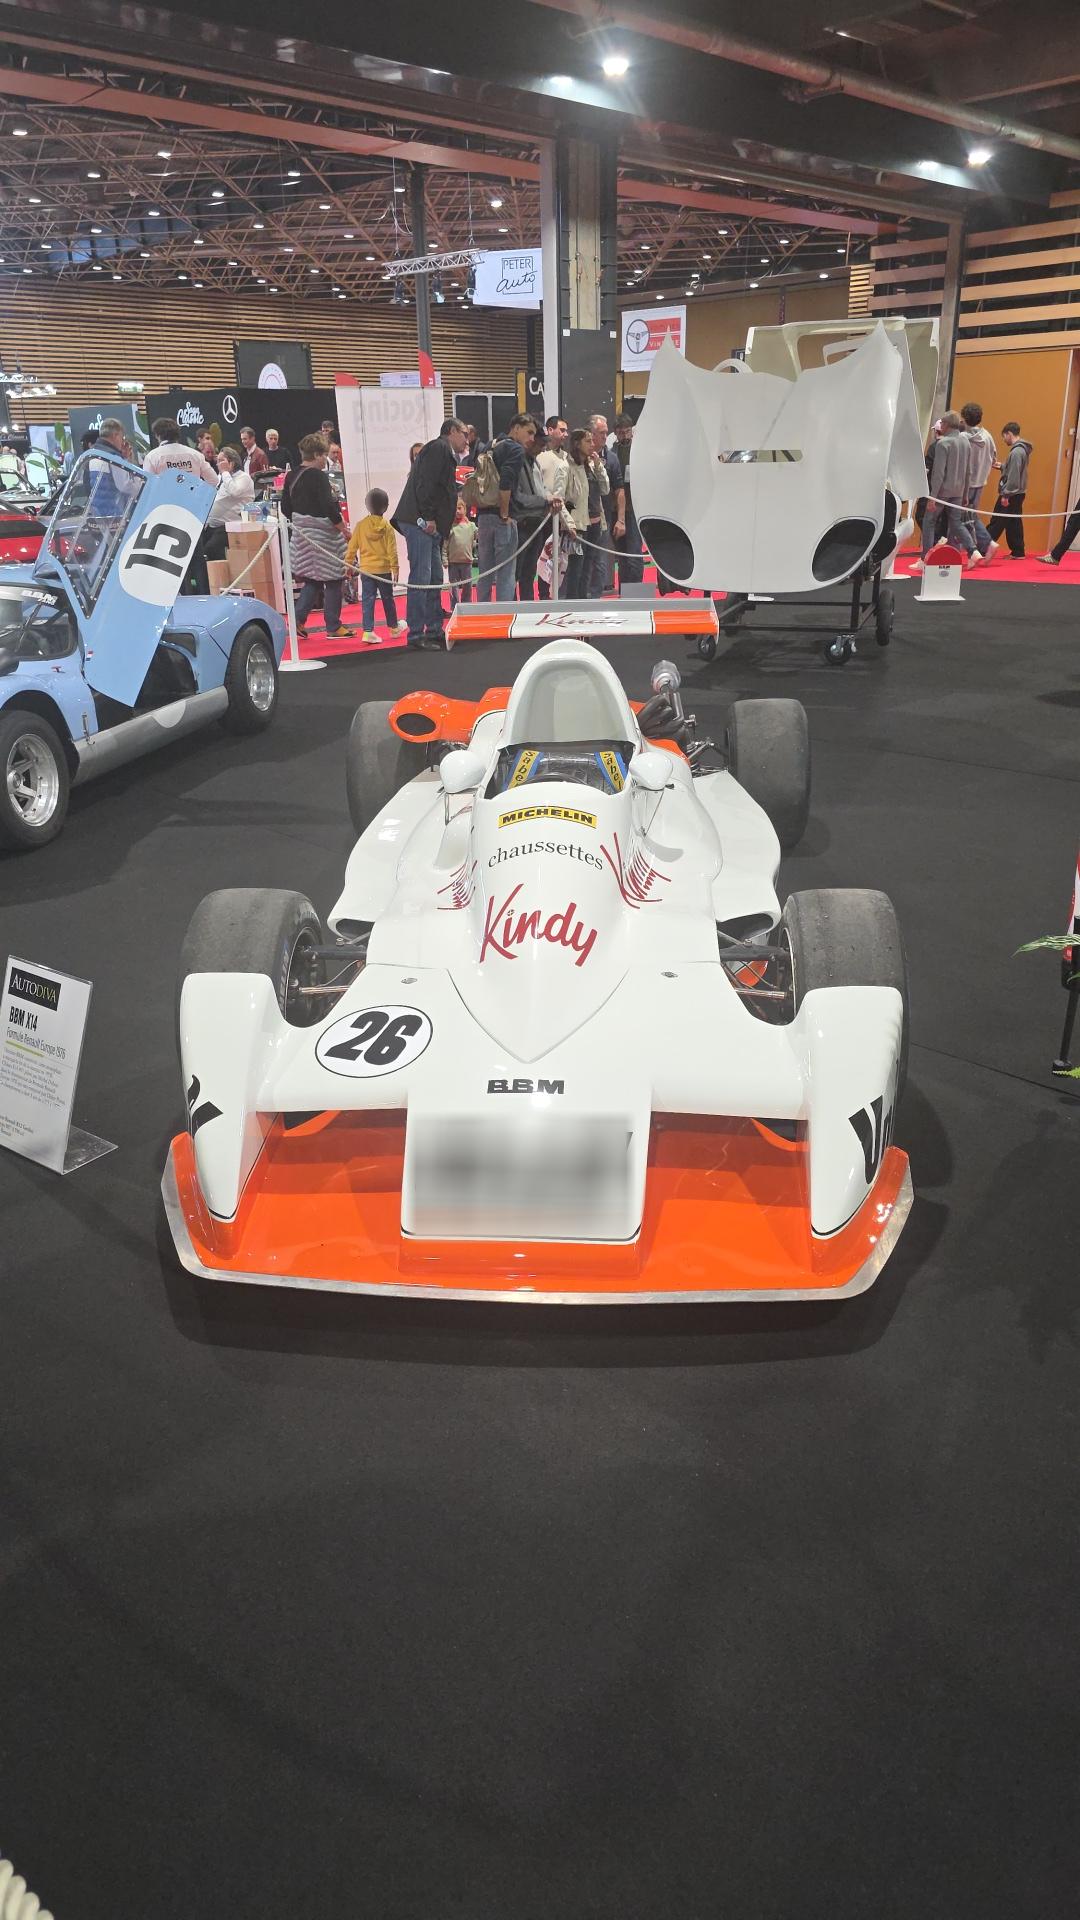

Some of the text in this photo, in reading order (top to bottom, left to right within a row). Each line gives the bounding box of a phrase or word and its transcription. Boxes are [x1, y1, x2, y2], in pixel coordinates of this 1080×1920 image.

[504, 258, 531, 270] PETER
[496, 270, 538, 292] auto
[166, 459, 192, 469] Racing
[124, 522, 192, 578] 15
[502, 808, 593, 824] MICHELIN
[488, 841, 603, 870] chaussettes
[479, 883, 598, 967] Kindy
[9, 1006, 38, 1032] BBM X14
[324, 1010, 423, 1066] 26
[487, 1079, 565, 1095] BBM
